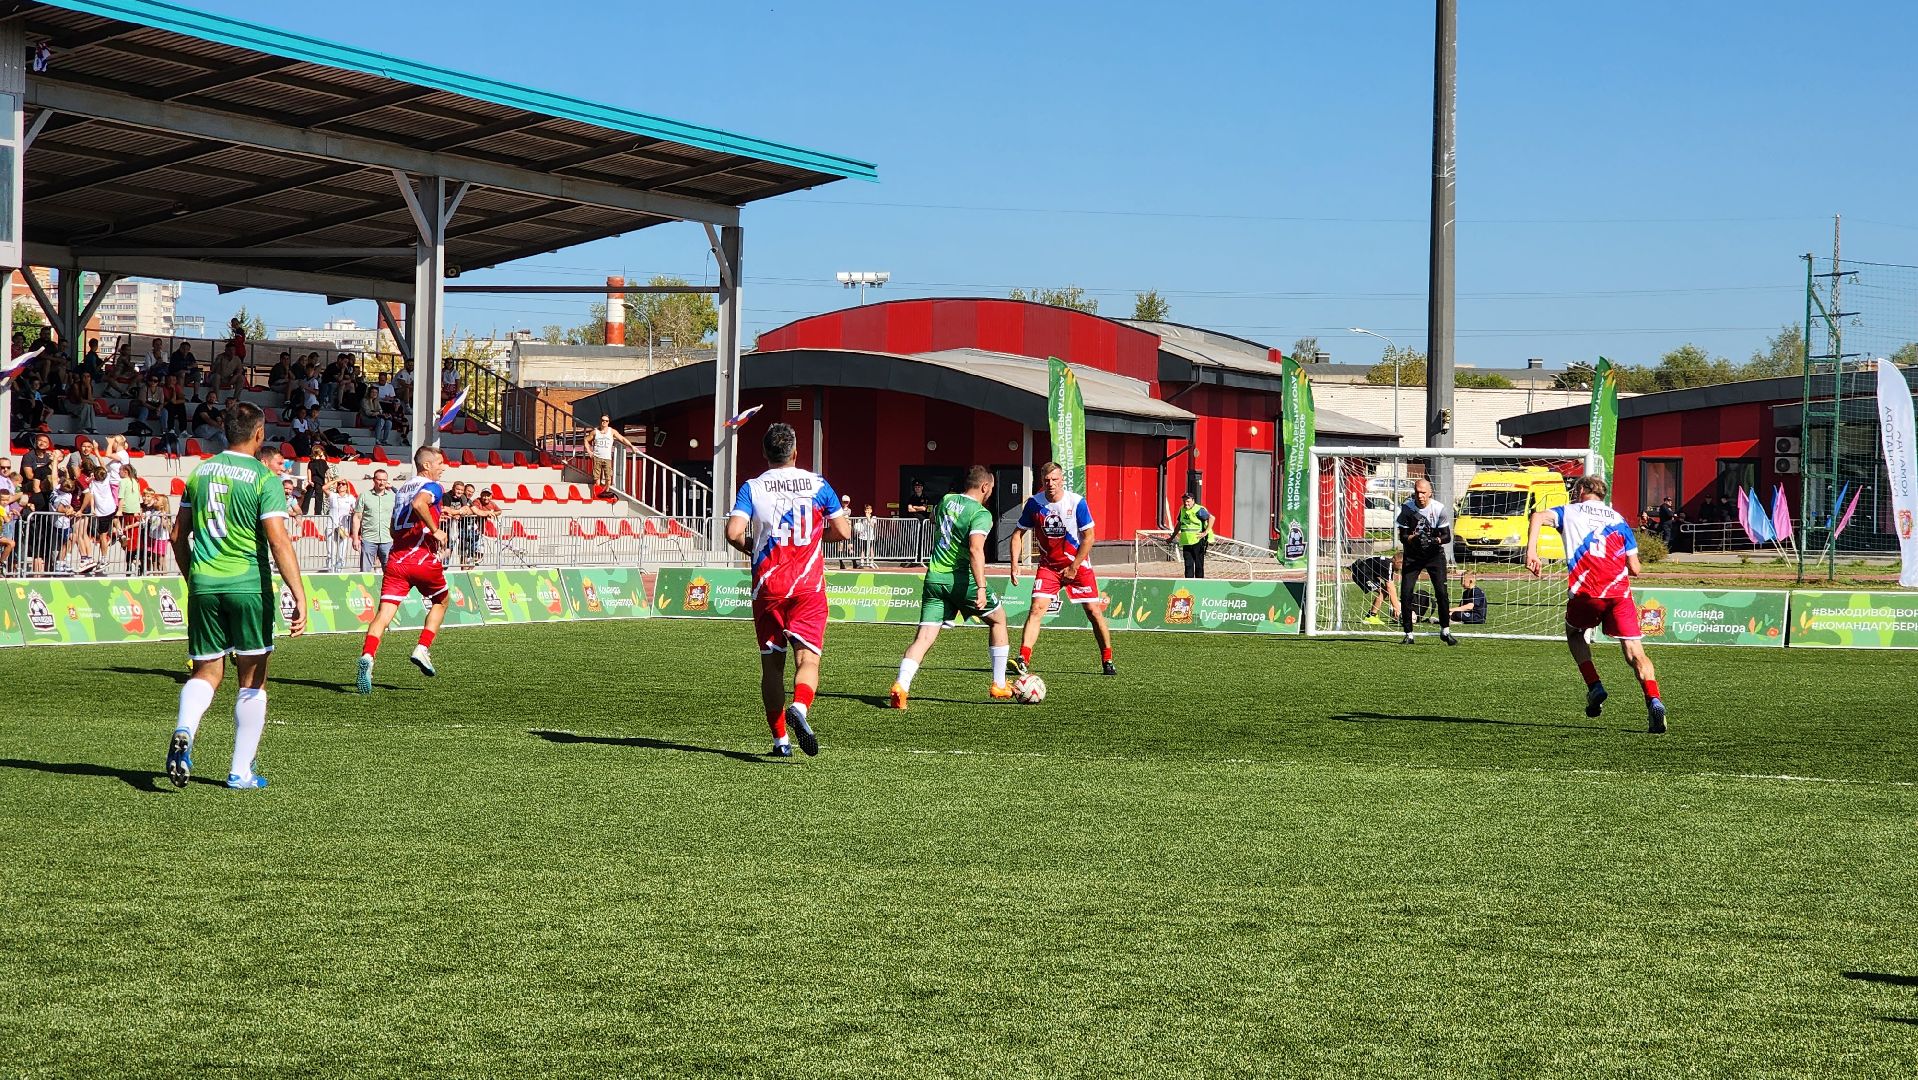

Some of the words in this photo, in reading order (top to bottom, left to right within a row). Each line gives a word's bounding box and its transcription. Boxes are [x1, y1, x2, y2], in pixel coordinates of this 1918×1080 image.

[207, 481, 228, 538] 5
[771, 495, 813, 546] 40
[1587, 518, 1607, 559] 3
[715, 585, 752, 596] Команд
[825, 585, 914, 596] #ВЫХОДИВОДВОР
[713, 597, 752, 608] Губерна
[827, 597, 922, 608] КОМАНДАГУБЕРНА
[1201, 597, 1247, 608] Команда
[1200, 610, 1266, 622] Губернатора
[1673, 609, 1724, 620] Команда
[1672, 621, 1746, 634] Губернатора
